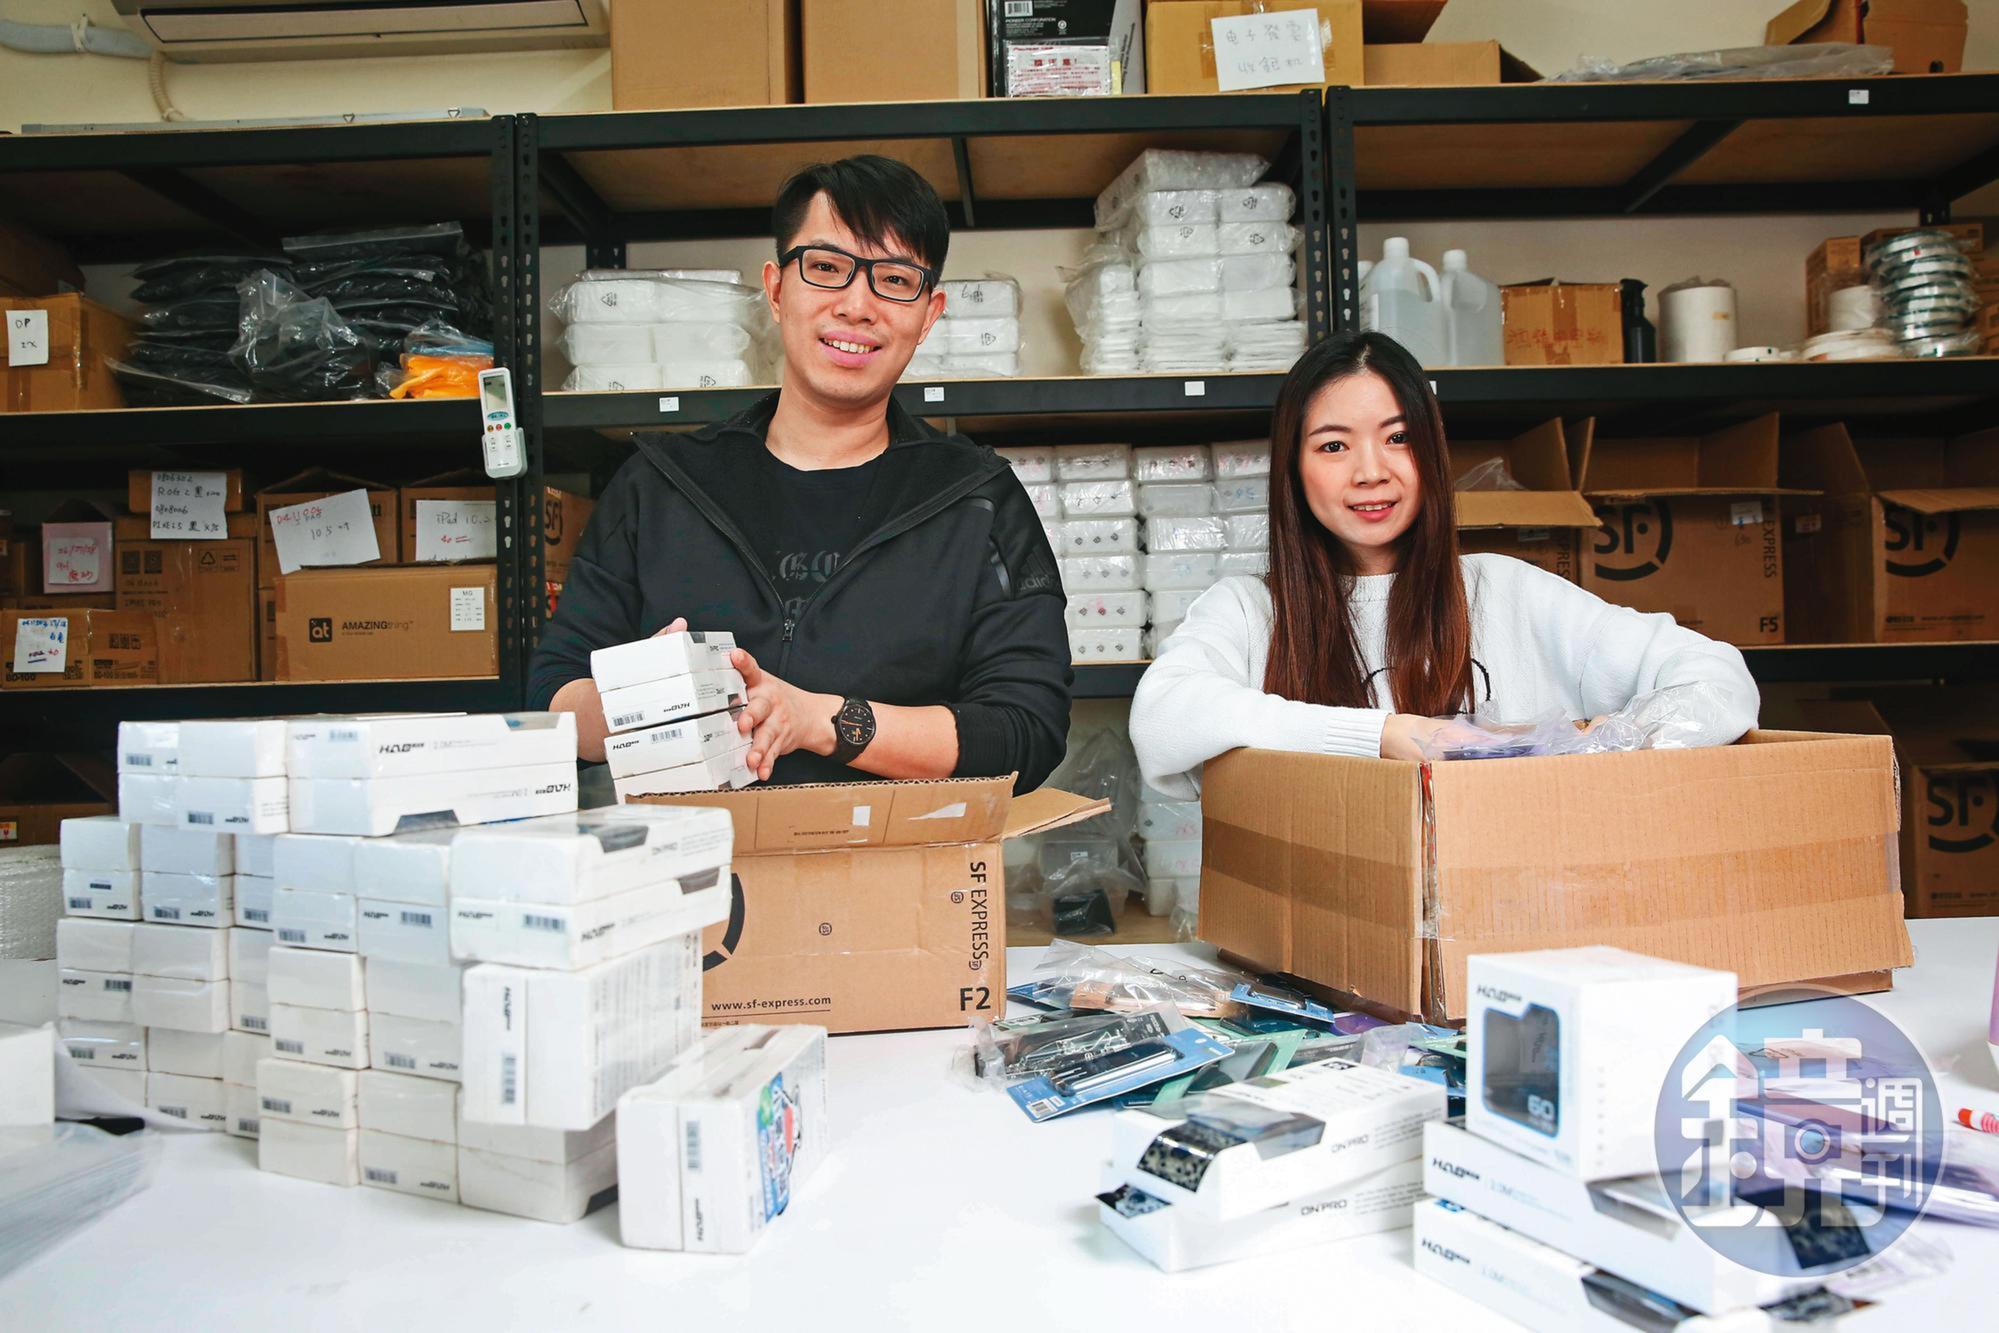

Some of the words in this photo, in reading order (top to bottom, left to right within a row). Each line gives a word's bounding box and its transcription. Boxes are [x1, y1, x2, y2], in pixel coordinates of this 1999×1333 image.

[1763, 520, 1777, 578] EXPRESS
[970, 861, 986, 883] SF
[971, 889, 989, 960] EXPRESS
[711, 996, 831, 1011] www.sf-express.com
[960, 987, 991, 1011] F2
